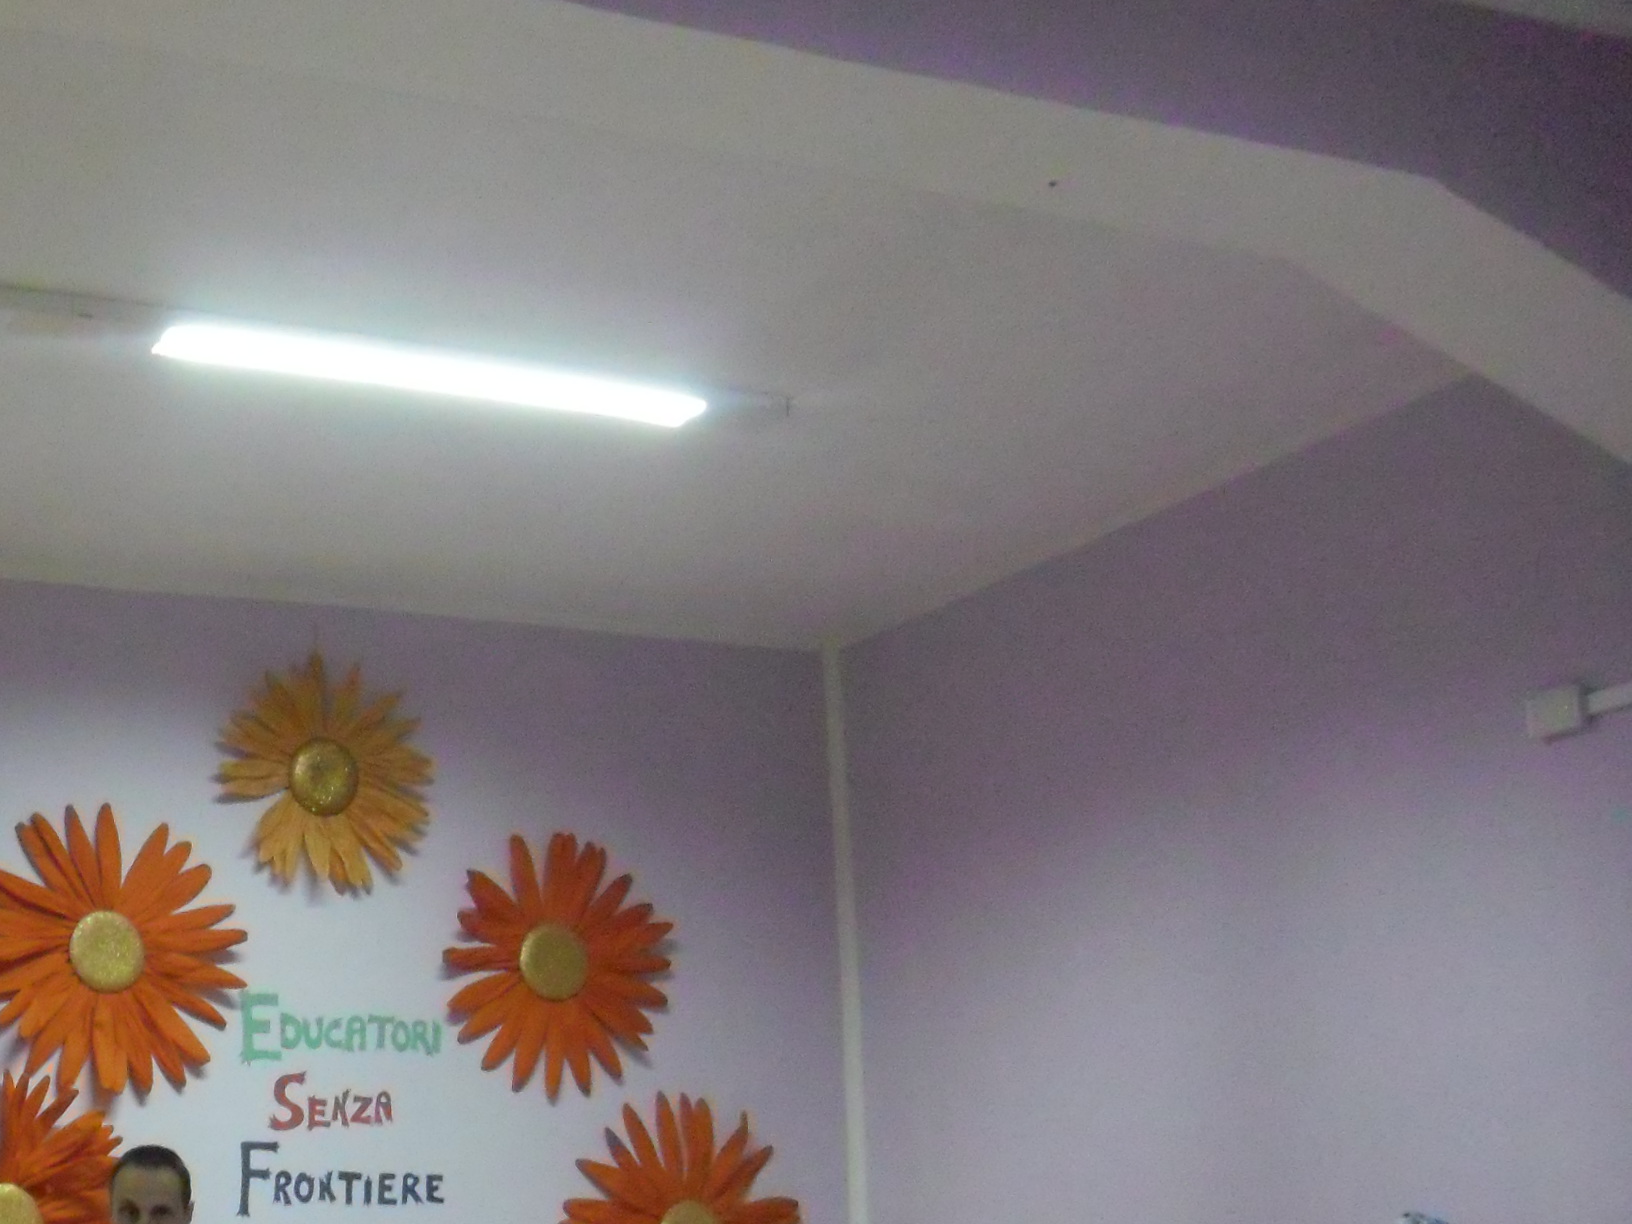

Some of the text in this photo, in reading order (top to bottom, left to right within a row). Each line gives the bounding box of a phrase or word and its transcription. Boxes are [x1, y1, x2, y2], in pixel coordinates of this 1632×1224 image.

[240, 991, 444, 1065] EDUCATORI
[269, 1070, 394, 1131] SENZA
[236, 1141, 445, 1218] FRONTIERE
